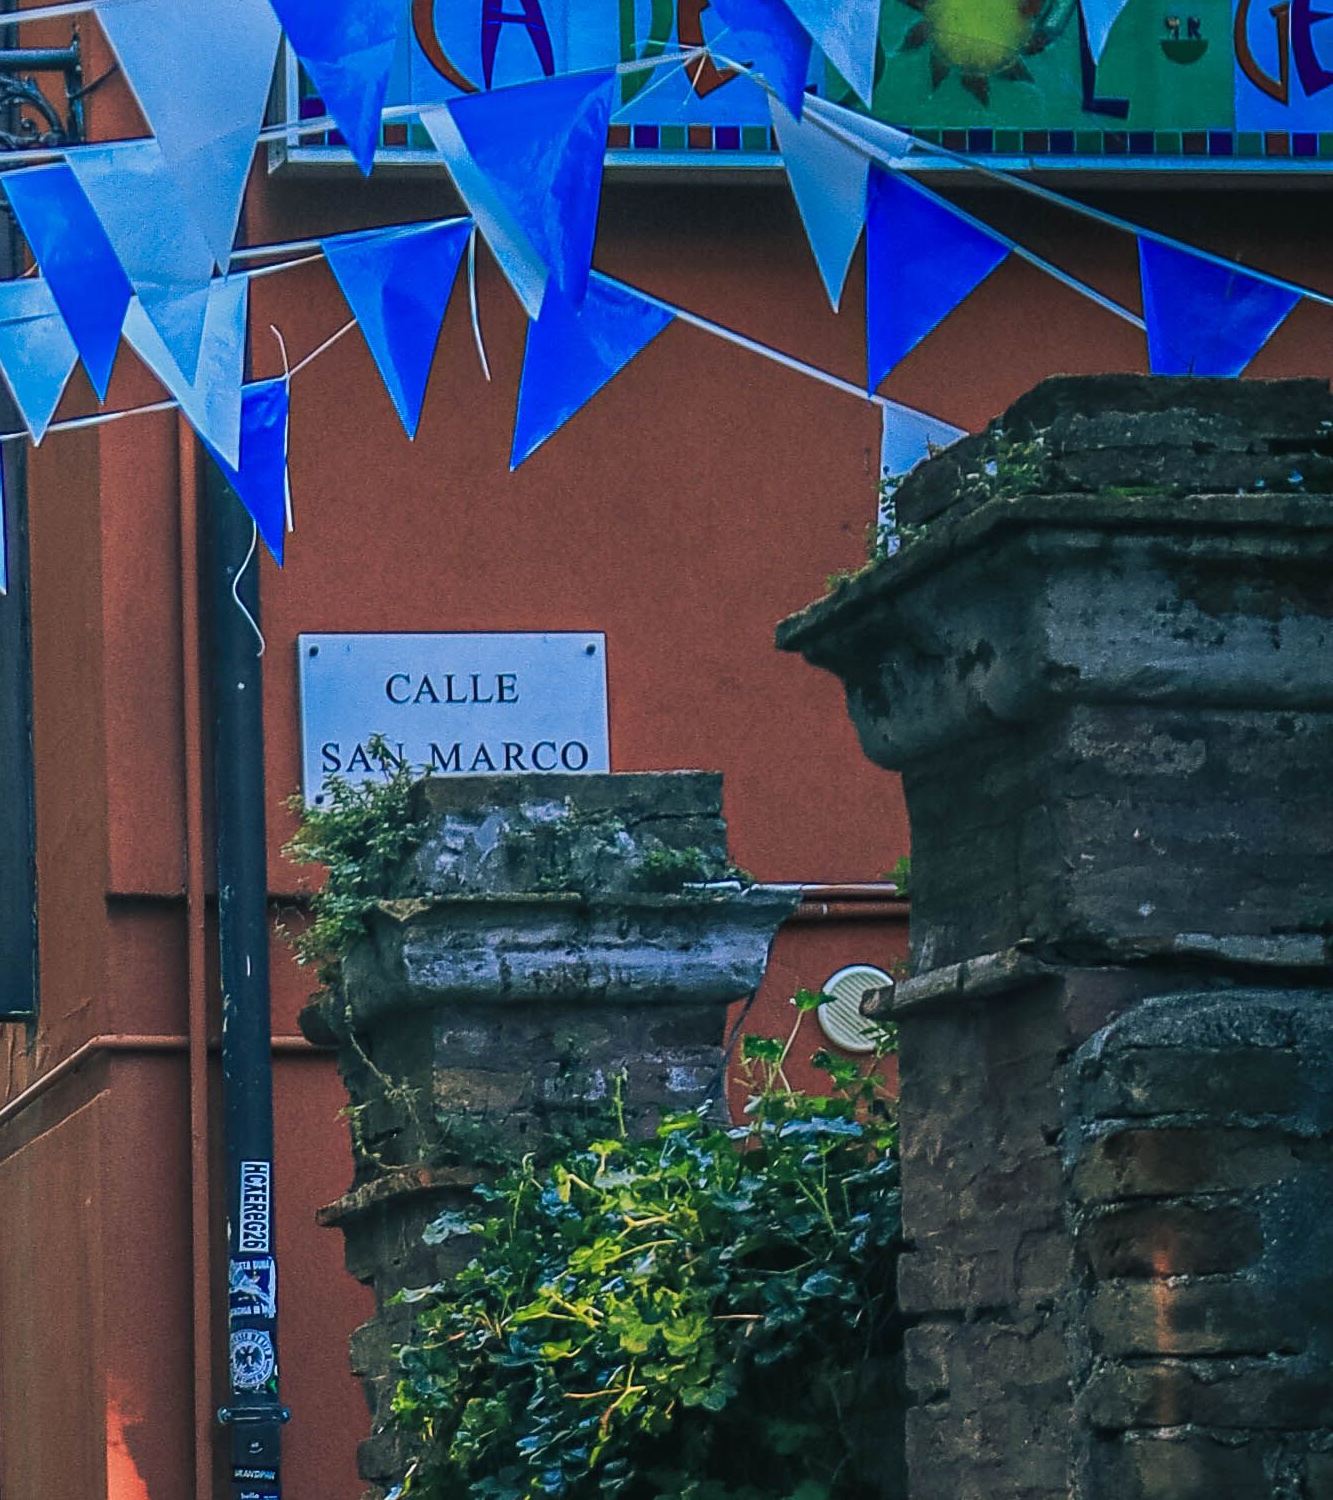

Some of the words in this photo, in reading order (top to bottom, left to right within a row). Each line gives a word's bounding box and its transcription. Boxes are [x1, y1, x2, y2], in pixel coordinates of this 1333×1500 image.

[384, 673, 520, 705] CALLE
[321, 741, 404, 773] SAN
[429, 740, 590, 773] MARCO
